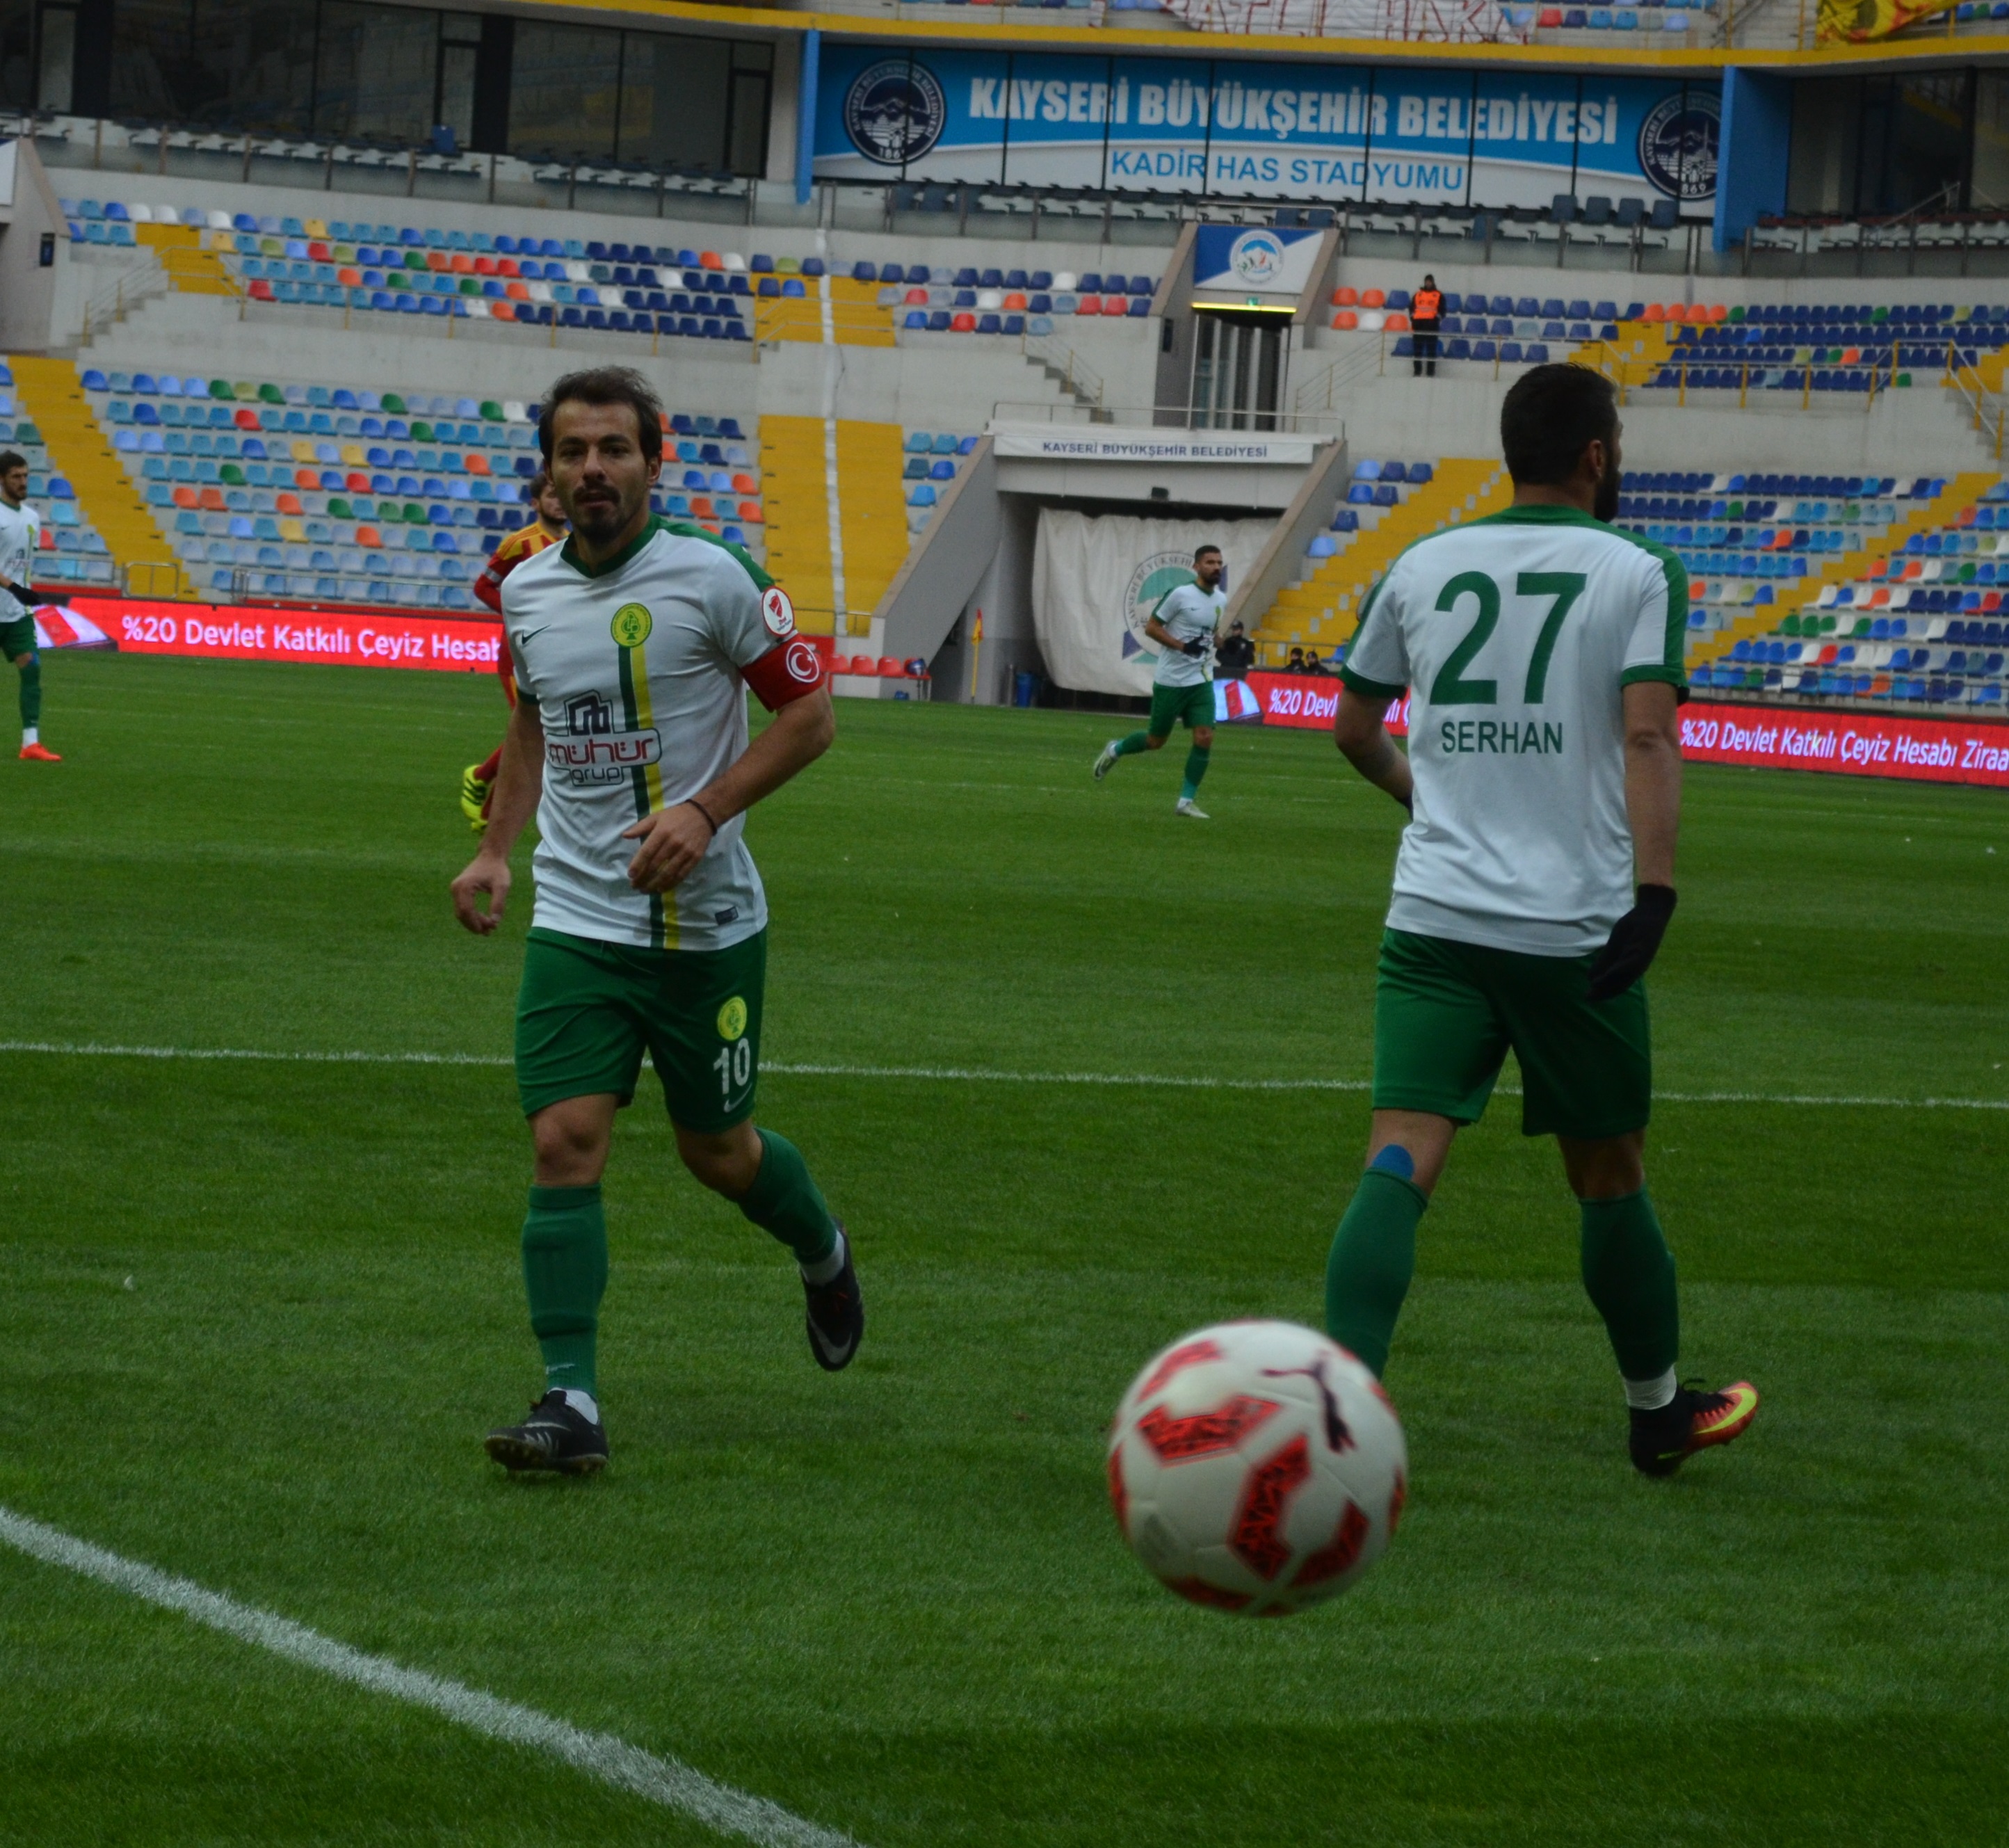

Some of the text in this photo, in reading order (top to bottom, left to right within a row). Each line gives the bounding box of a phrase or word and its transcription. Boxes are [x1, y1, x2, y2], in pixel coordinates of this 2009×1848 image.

[969, 76, 1618, 145] KAYSERİ BÜYÜKŞEHİR BELEDİYESİ
[1112, 149, 1462, 190] KADİR HAS STADYUMU
[1681, 183, 1707, 194] 869
[1043, 442, 1268, 458] KAYSERİ BÜYÜKŞEHİR BELEDİYESİ
[121, 615, 177, 643] %20
[185, 619, 266, 648] Devlet
[273, 625, 350, 653] Katkılı
[357, 629, 424, 660] Çeyiz
[1429, 571, 1588, 705] 27
[1269, 688, 1339, 718] %20 Devl
[1442, 721, 1563, 754] SERHAN
[1680, 718, 2009, 771] %20 Devlet Katkılı Çeyiz Hesabı Ziraa
[572, 767, 620, 783] grup
[713, 1038, 750, 1095] 10
